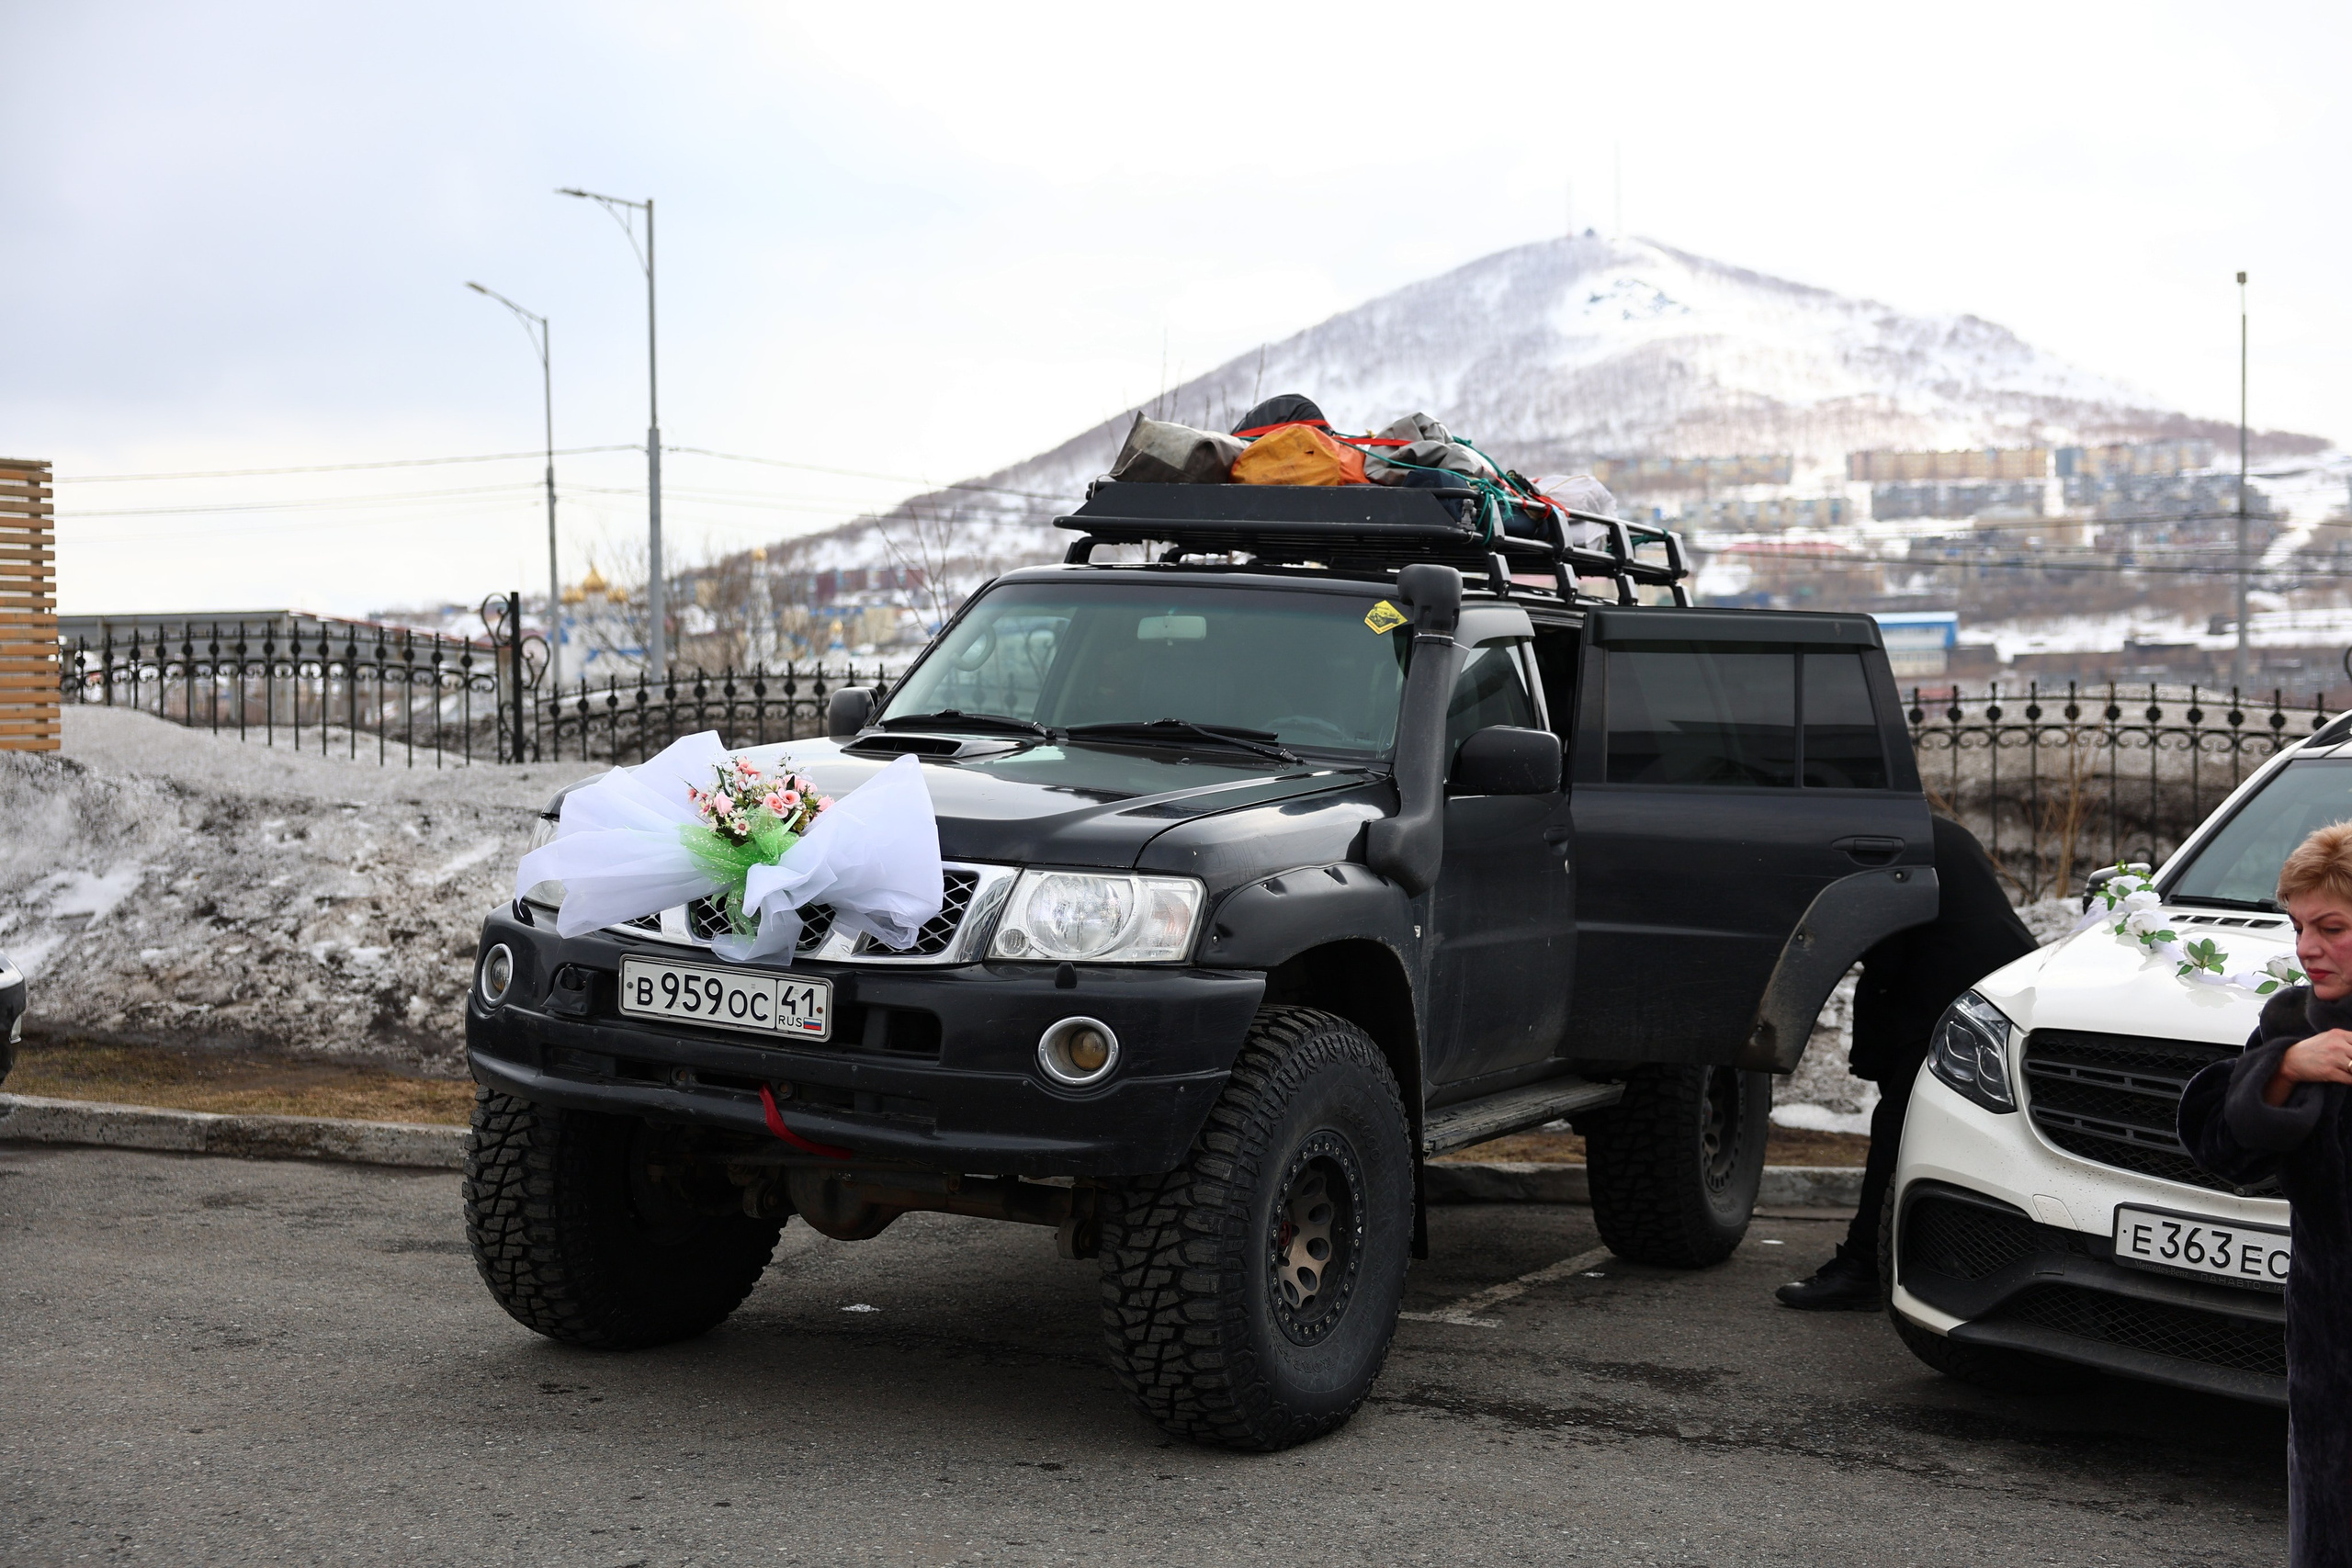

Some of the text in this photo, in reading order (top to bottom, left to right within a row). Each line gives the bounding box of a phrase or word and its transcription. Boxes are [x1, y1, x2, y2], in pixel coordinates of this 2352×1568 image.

[637, 972, 814, 1021] В959ОС 41
[778, 1015, 803, 1028] RUS
[2134, 1260, 2189, 1279] Mercedes-Benz
[2200, 1273, 2261, 1291] ПАНАВТО
